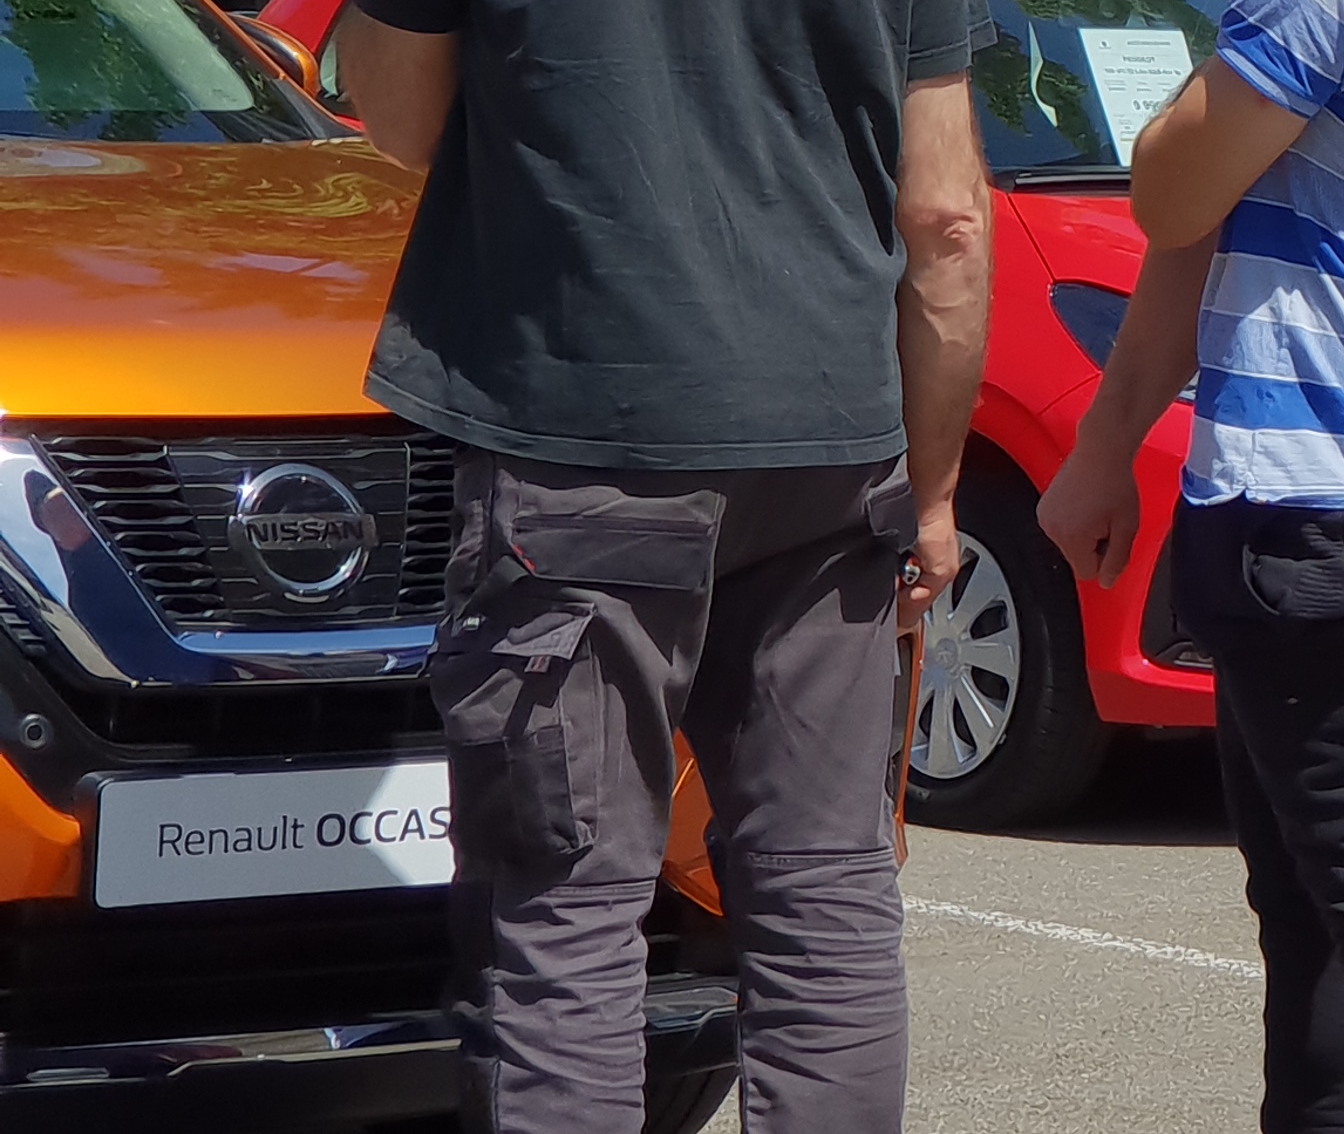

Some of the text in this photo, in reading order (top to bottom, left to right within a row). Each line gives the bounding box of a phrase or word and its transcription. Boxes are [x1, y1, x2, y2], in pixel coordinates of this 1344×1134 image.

[246, 520, 364, 543] NISSAN
[158, 806, 450, 858] Renault OCCAS
